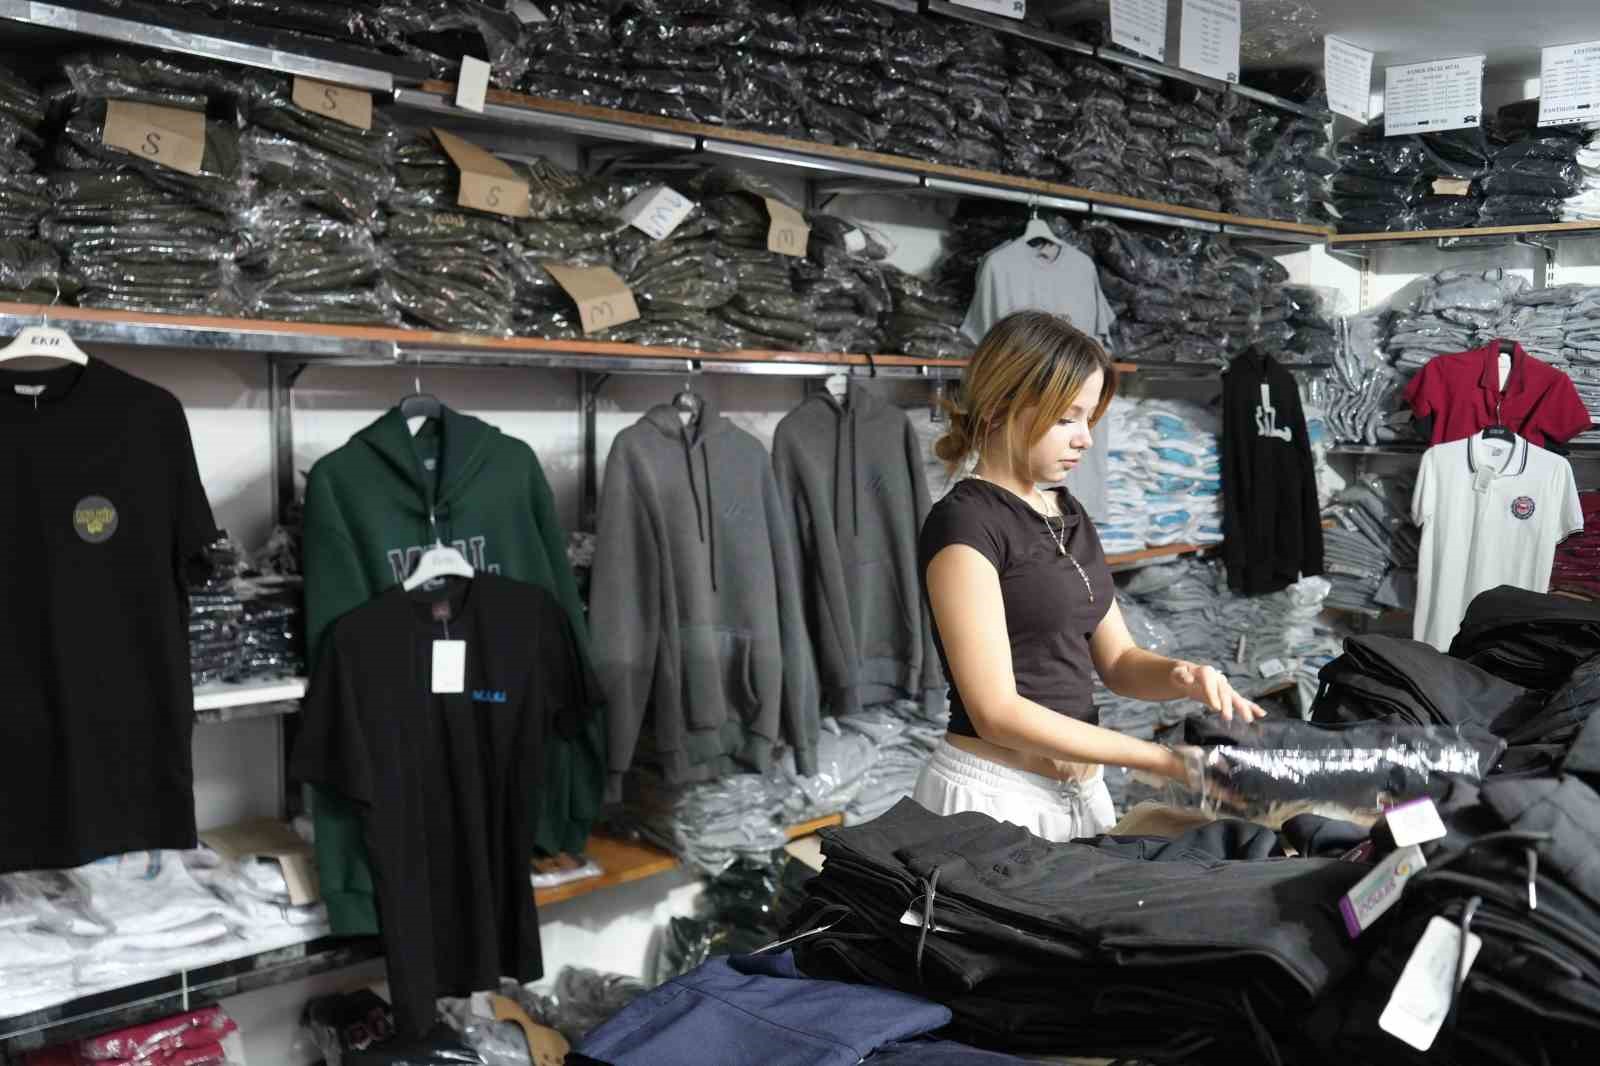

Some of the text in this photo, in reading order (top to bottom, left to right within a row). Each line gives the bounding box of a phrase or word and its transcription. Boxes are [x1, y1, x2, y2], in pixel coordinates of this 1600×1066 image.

[322, 86, 338, 111] S
[141, 131, 161, 156] S
[486, 185, 503, 208] S
